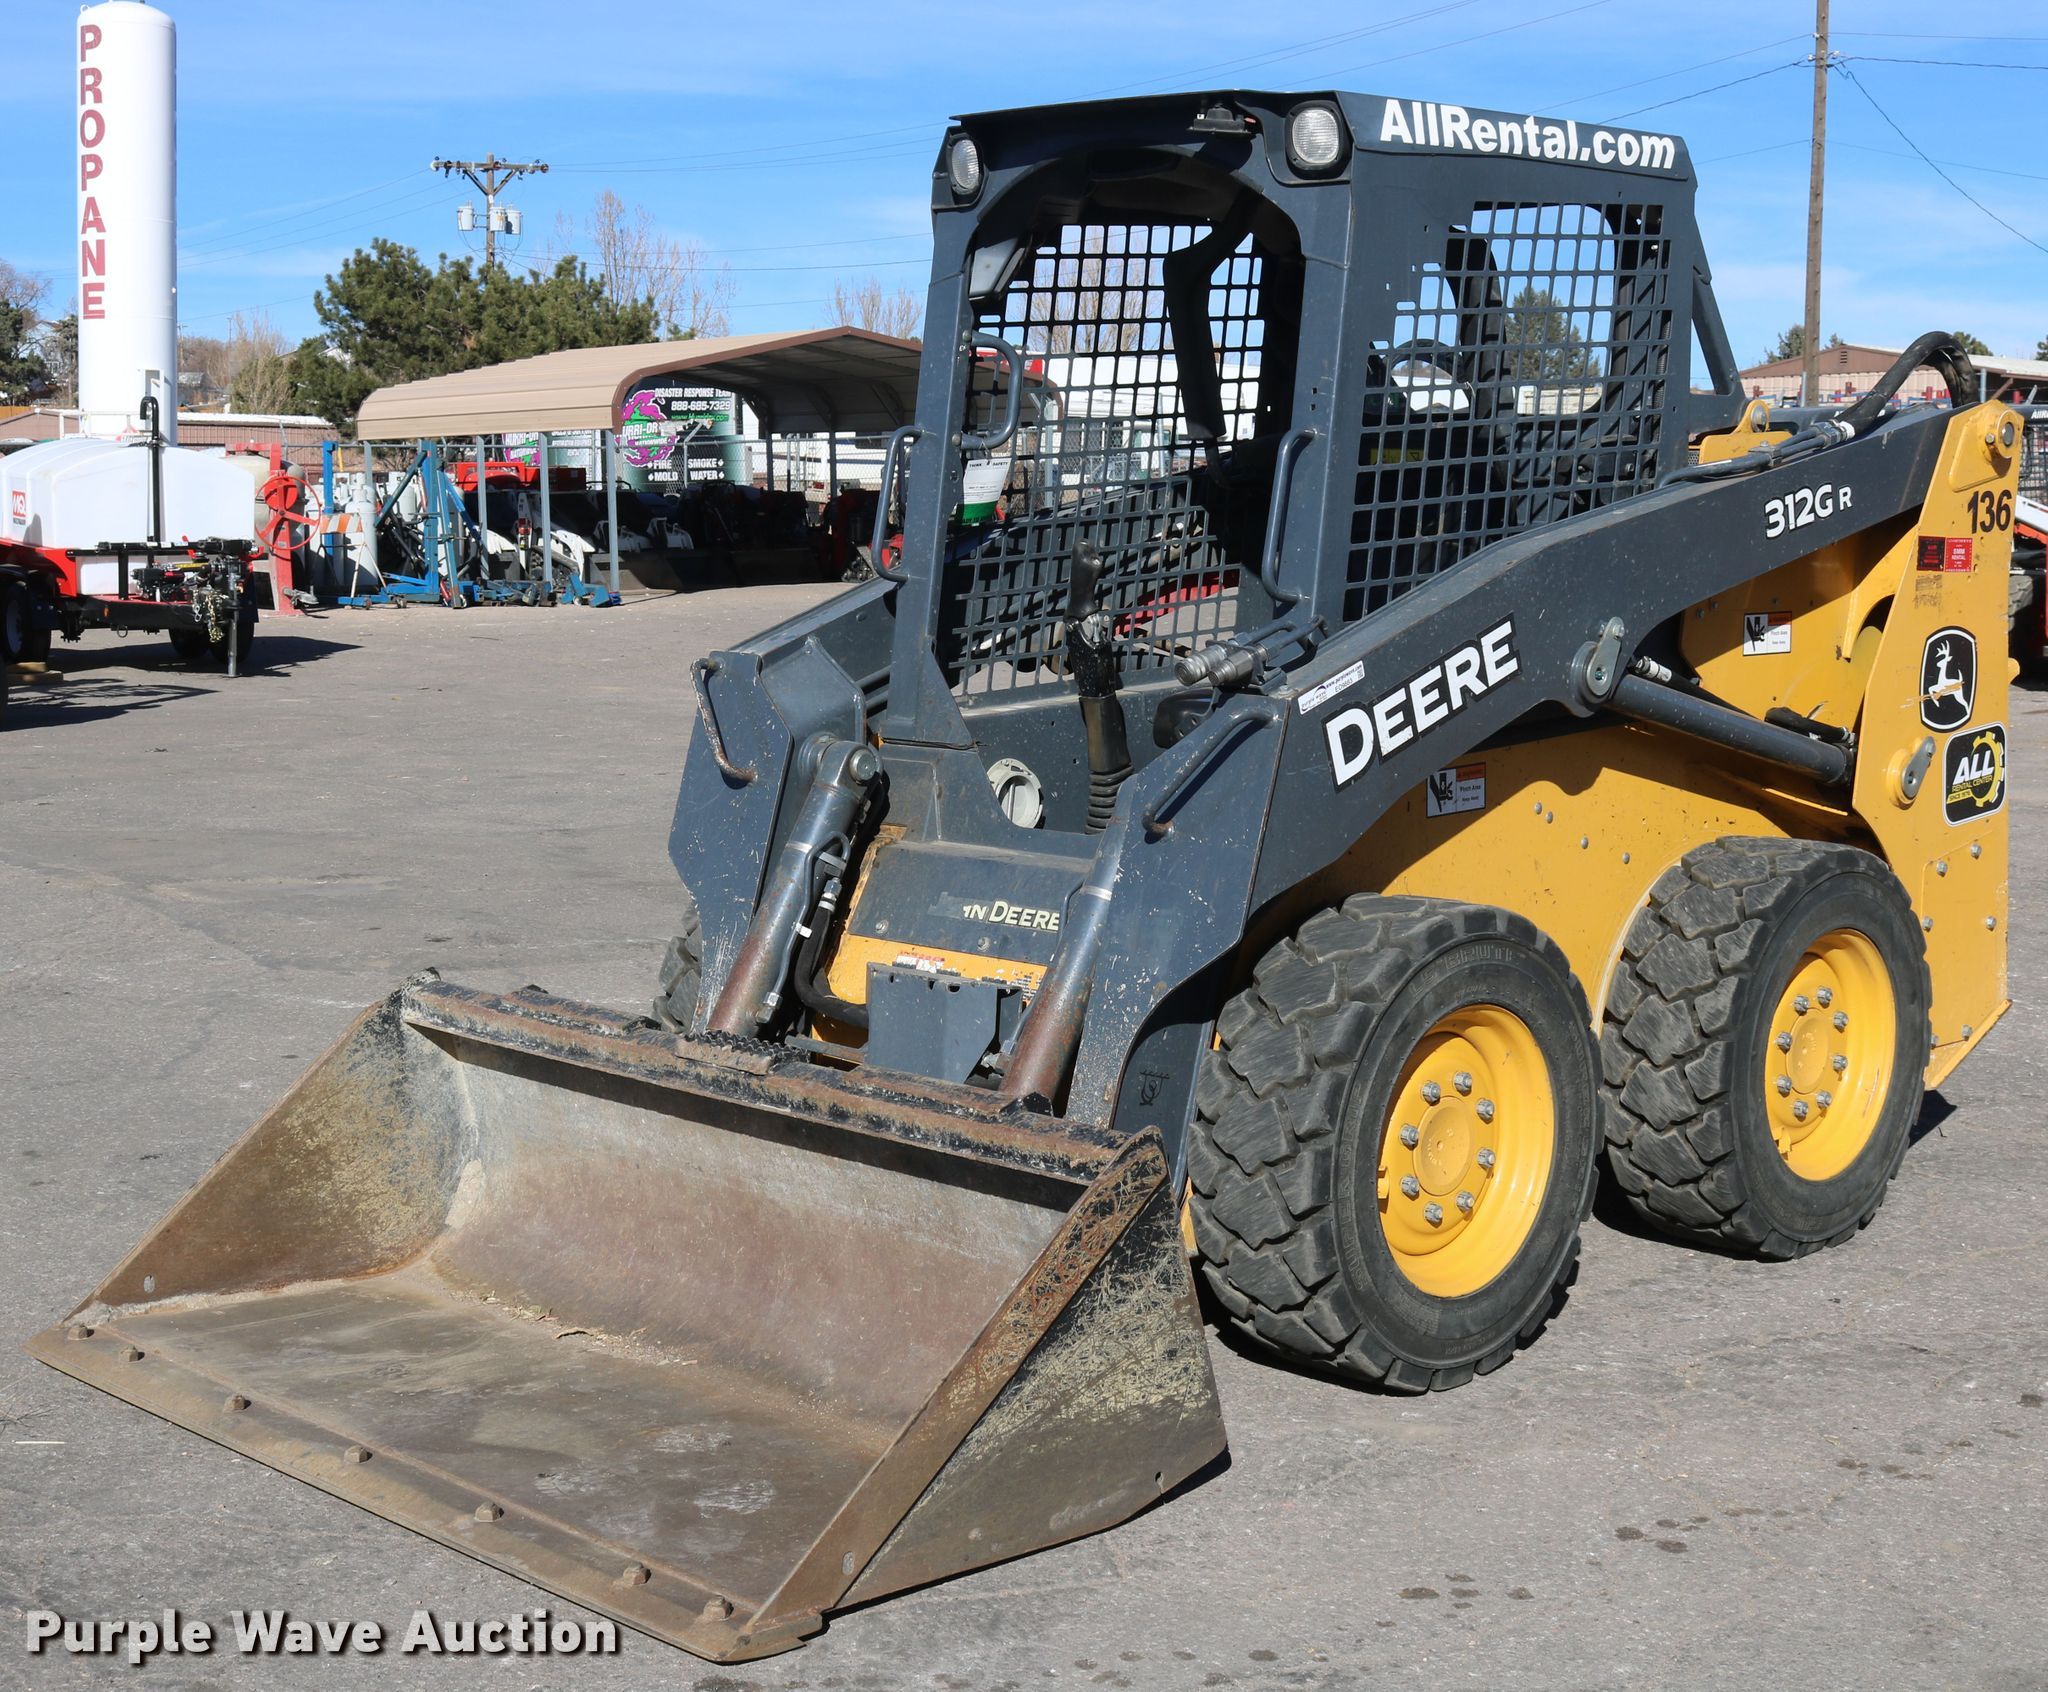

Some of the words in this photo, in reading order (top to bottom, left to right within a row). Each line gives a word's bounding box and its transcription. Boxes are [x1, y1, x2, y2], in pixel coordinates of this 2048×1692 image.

[1380, 98, 1676, 170] AllRental.com
[80, 24, 106, 320] PROPANE
[655, 388, 683, 397] DISASTER
[684, 388, 714, 397] RESPONSE
[653, 460, 672, 469] FIRE
[688, 459, 717, 468] SMOKE
[655, 472, 678, 481] MOLD
[690, 471, 718, 480] WATER
[1765, 484, 1833, 538] 312G
[1839, 486, 1853, 511] R
[1967, 489, 2012, 534] 136
[1326, 620, 1519, 786] DEERE
[1952, 781, 1972, 792] RENTAL
[1972, 775, 1993, 786] CENTER
[1953, 750, 1994, 785] ALL
[989, 901, 1060, 931] DEERE
